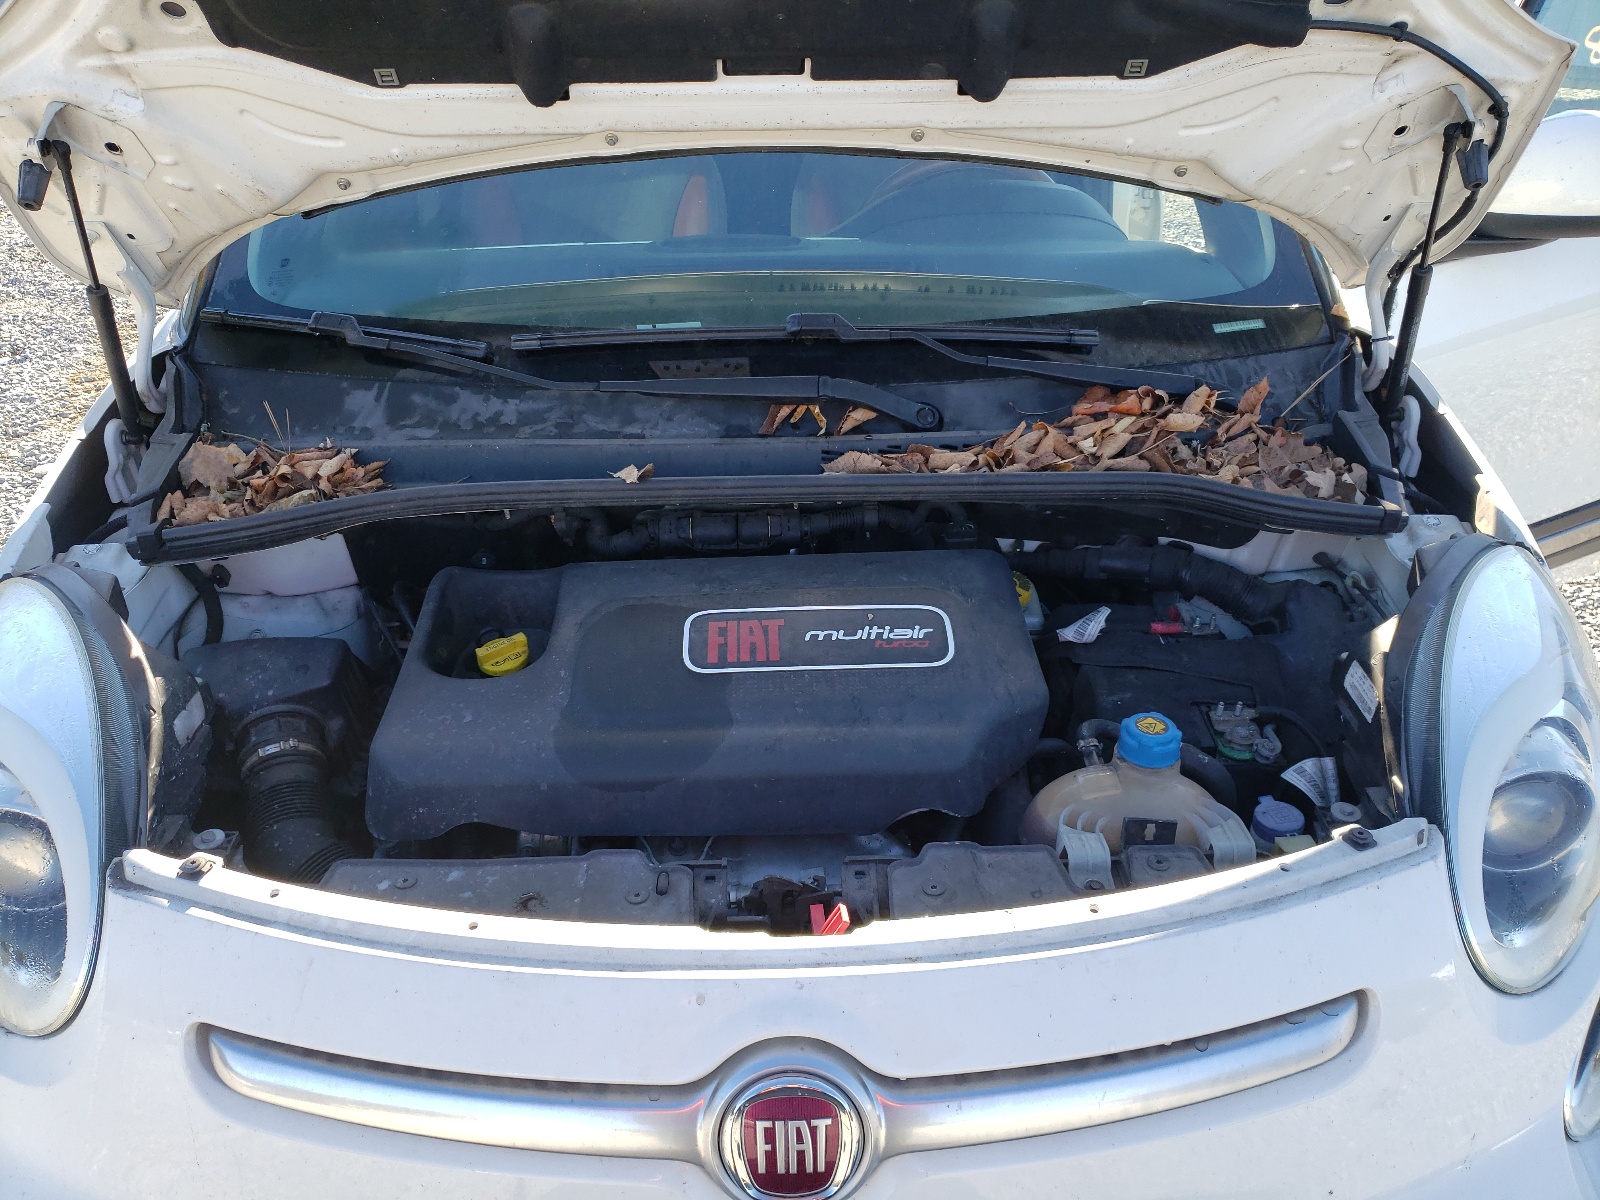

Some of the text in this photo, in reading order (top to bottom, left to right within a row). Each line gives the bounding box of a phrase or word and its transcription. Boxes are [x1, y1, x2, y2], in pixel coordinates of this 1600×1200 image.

[707, 619, 785, 664] FIAT
[804, 625, 934, 641] multiair
[875, 639, 930, 648] turbo
[756, 1118, 832, 1174] FIAT
